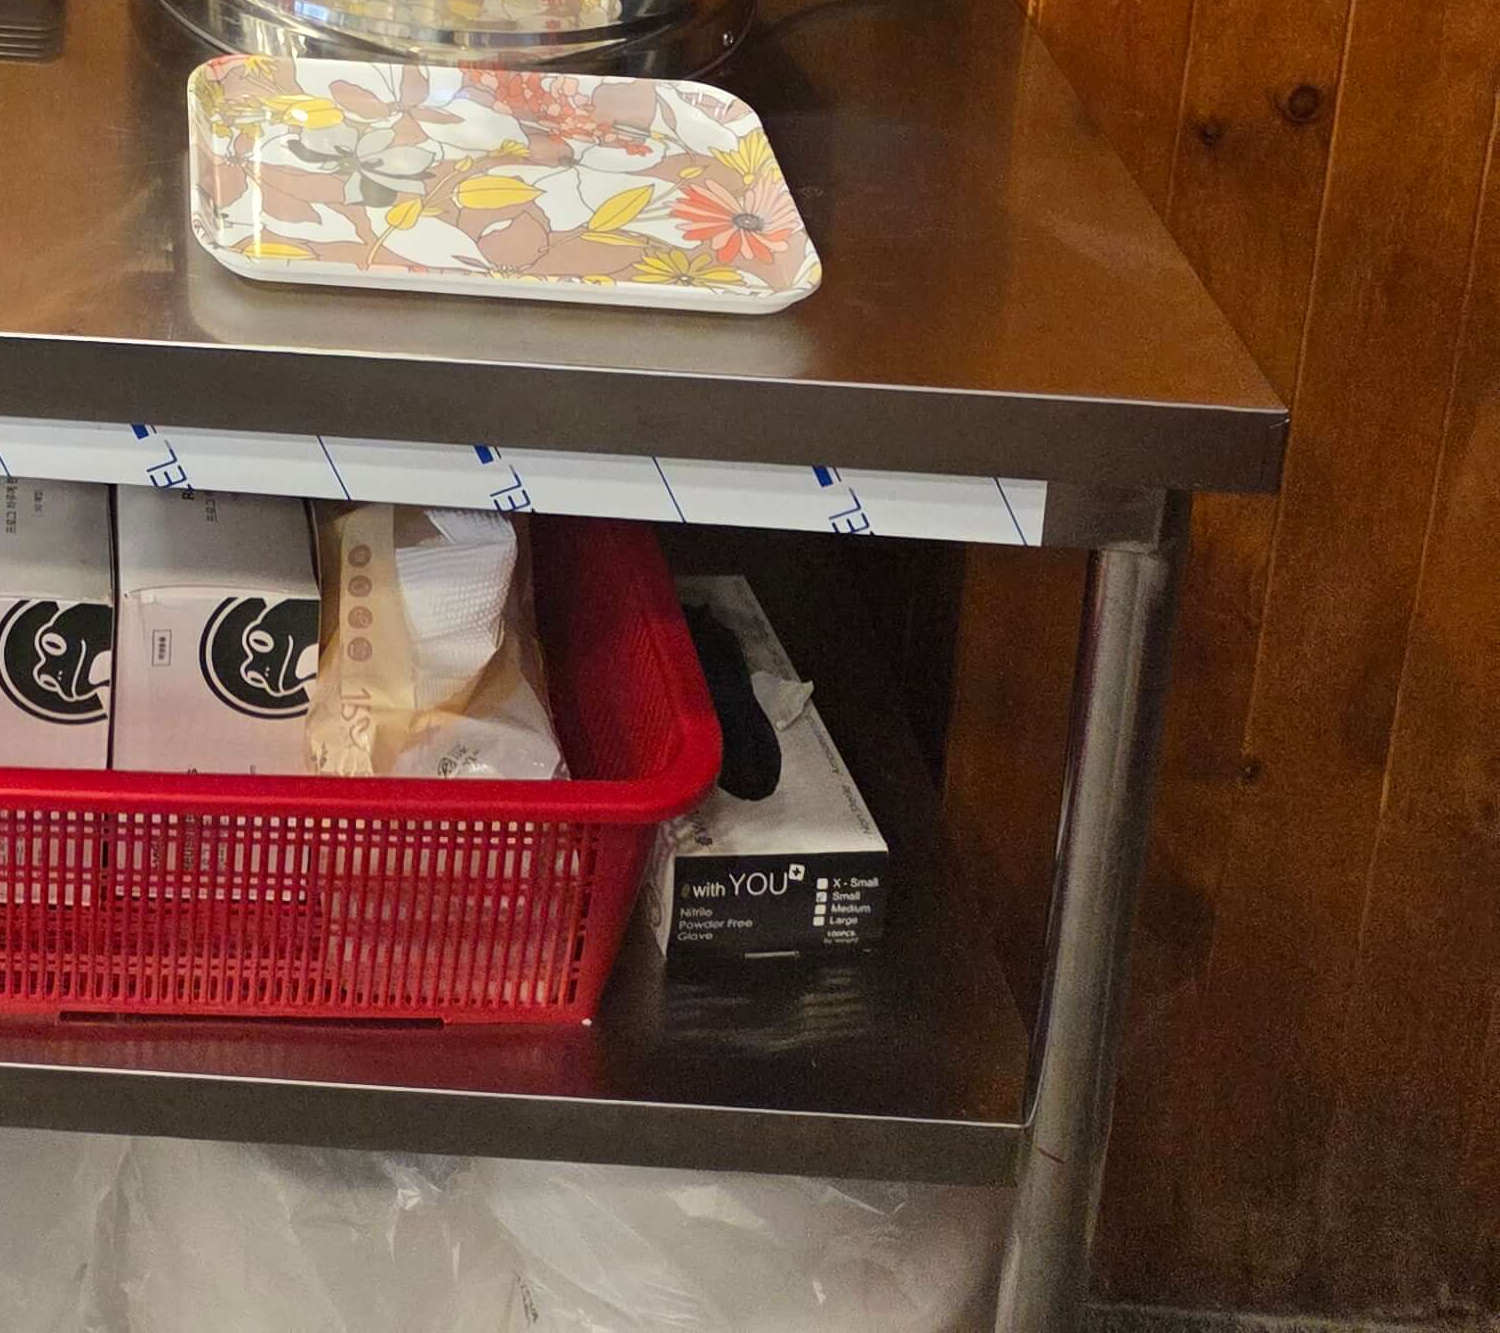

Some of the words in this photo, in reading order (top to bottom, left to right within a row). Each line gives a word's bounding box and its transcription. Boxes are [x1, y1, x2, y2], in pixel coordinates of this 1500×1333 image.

[693, 882, 725, 898] with
[729, 871, 787, 896] YOU
[850, 877, 879, 888] Small
[832, 891, 861, 901] Small
[680, 908, 713, 918] Nitrile
[831, 904, 871, 913] Medium
[679, 920, 724, 930] Powder
[727, 918, 753, 928] Free
[829, 917, 858, 926] Large
[677, 932, 713, 941] Glove
